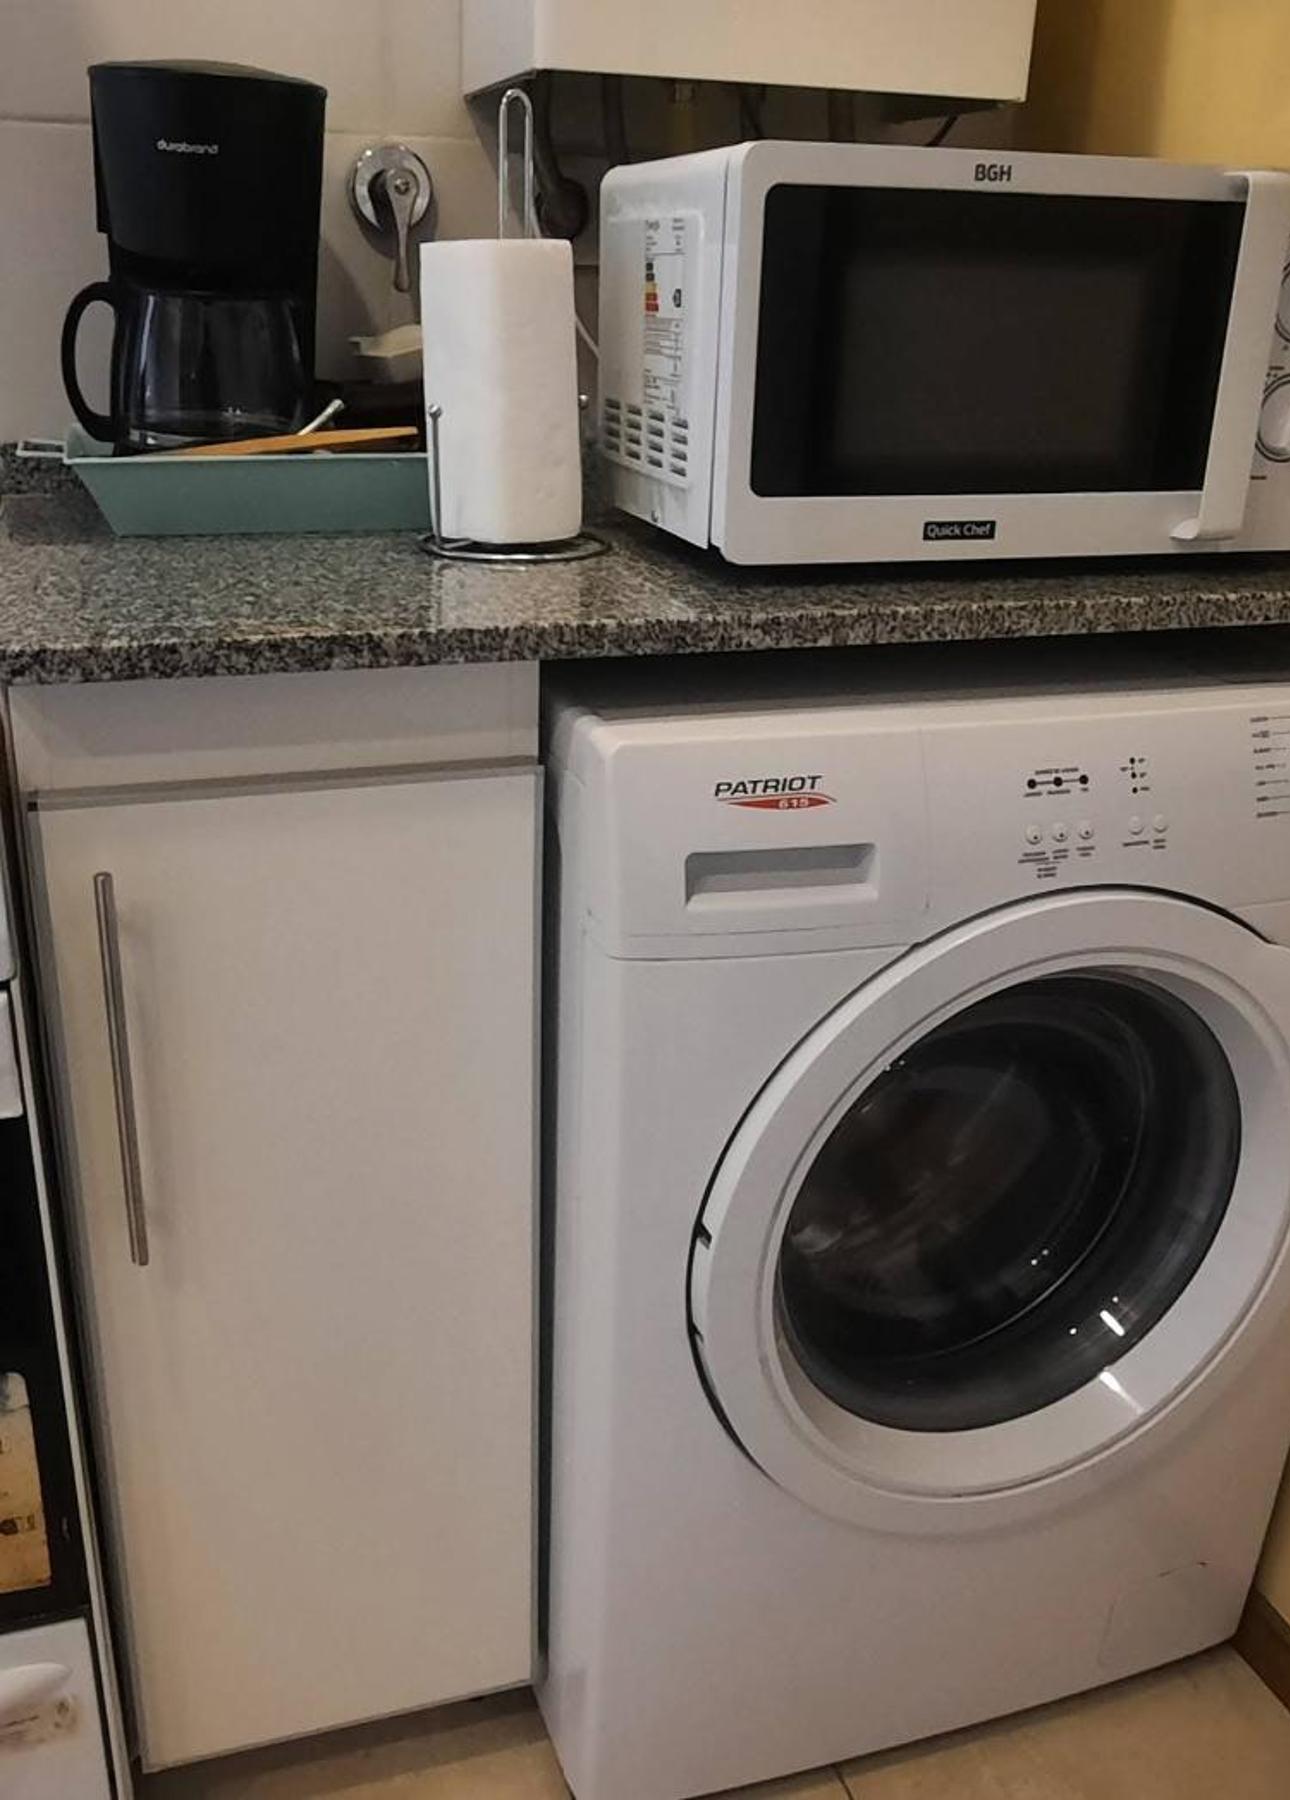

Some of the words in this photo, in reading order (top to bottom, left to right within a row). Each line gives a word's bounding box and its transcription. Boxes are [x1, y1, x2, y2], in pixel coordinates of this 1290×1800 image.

[975, 163, 1013, 182] BGH
[927, 523, 962, 538] Quick
[963, 522, 991, 537] Chef
[715, 775, 823, 797] PATRIOT
